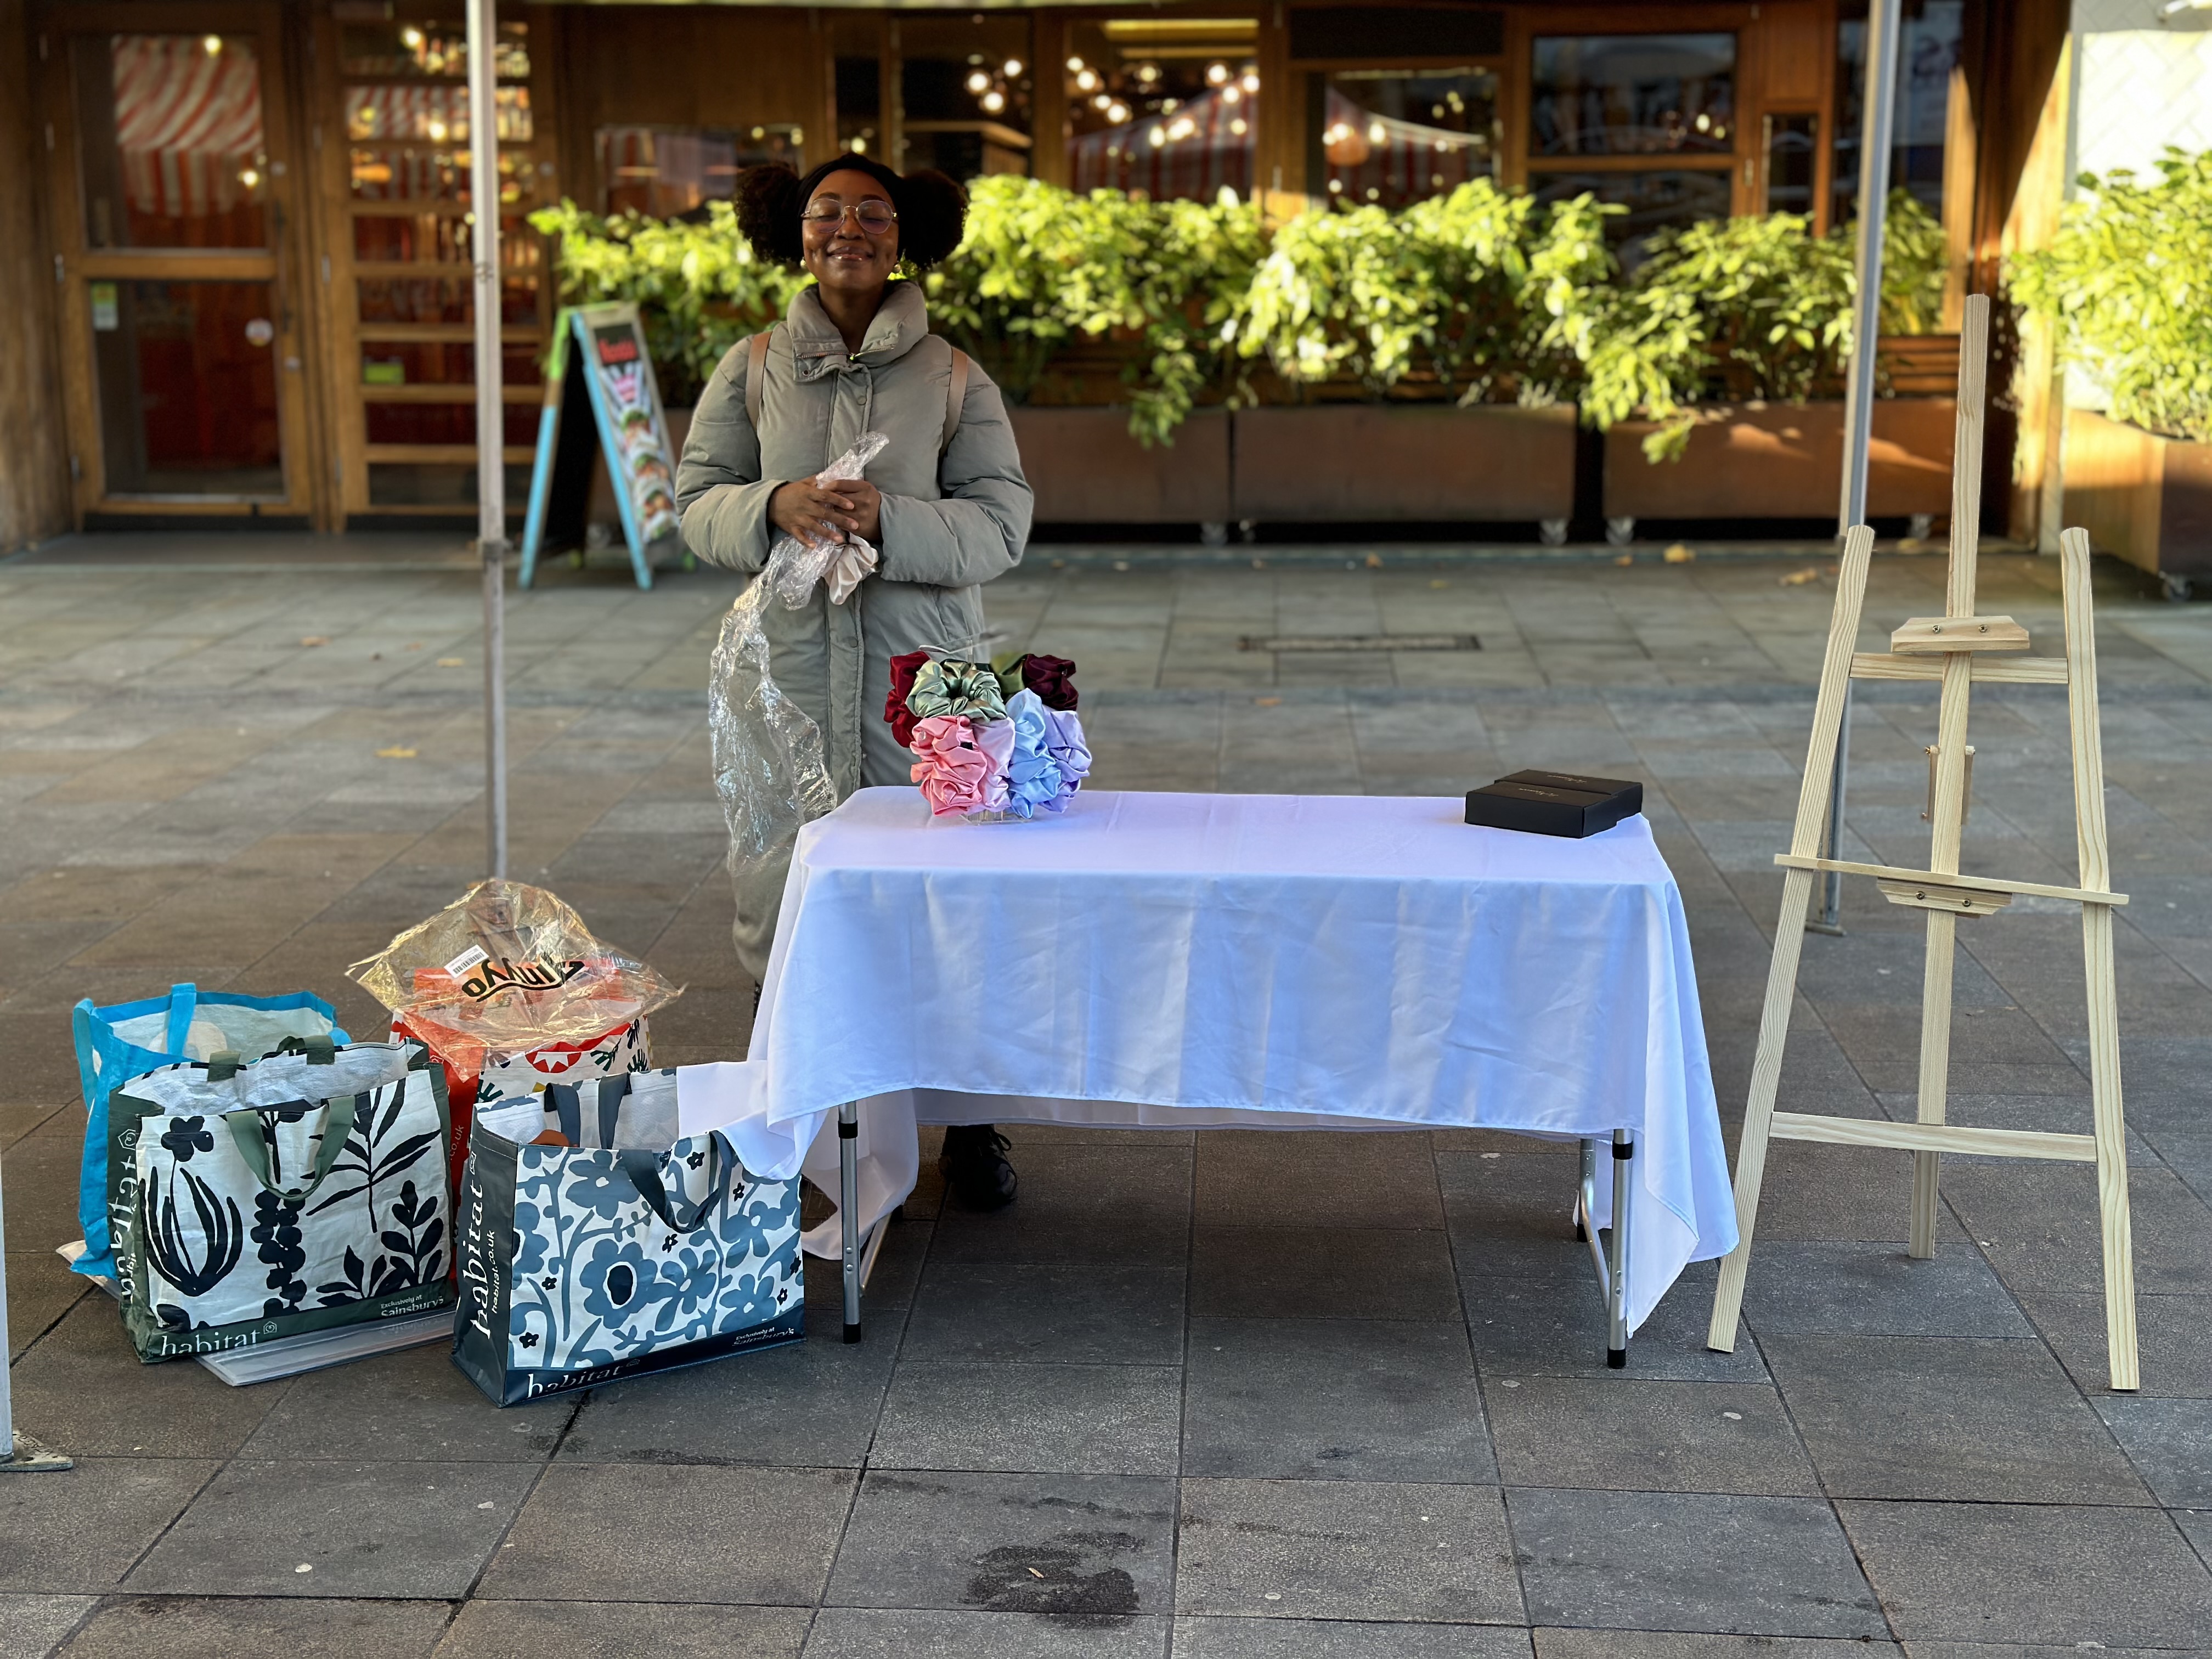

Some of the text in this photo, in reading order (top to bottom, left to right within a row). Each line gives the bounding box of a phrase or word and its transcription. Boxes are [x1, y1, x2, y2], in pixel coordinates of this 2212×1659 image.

[462, 1180, 490, 1340] habitat
[487, 1229, 499, 1314] habitat.co.uk
[381, 1296, 415, 1309] Exclusively
[160, 1329, 260, 1356] habitat
[732, 1328, 794, 1346] Sainsbury's
[736, 1329, 768, 1340] Exclusively
[524, 1365, 624, 1399] habitat
